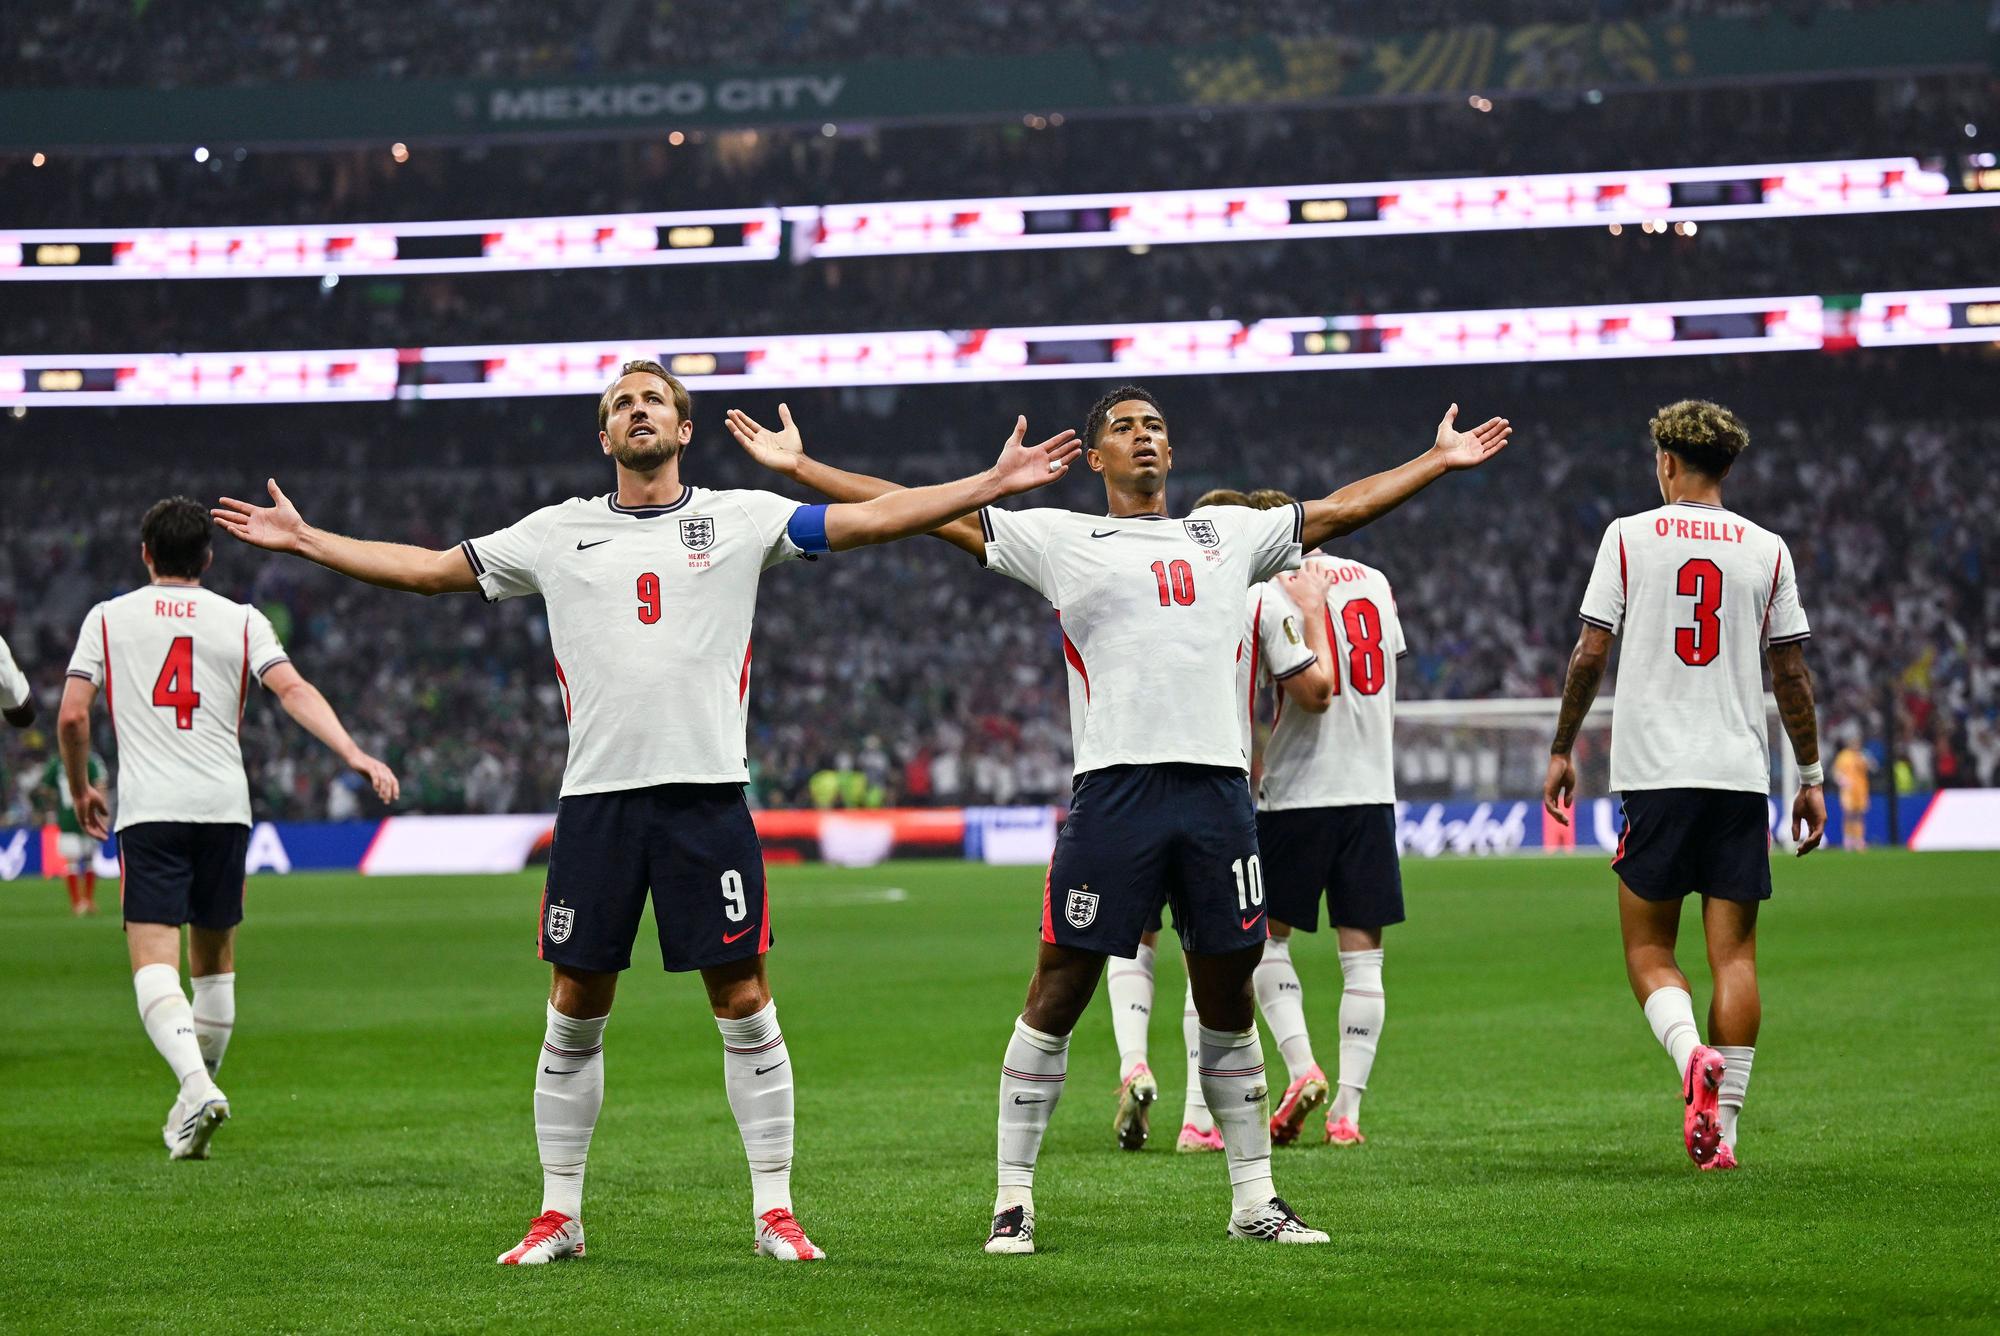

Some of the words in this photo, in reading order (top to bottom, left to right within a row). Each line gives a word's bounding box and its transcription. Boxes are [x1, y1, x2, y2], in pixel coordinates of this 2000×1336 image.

[491, 82, 706, 121] MEXICO
[714, 75, 846, 112] CITY
[1655, 518, 1746, 544] O'REILLY
[637, 572, 662, 625] 9
[1151, 559, 1196, 607] 10
[155, 600, 198, 618] RICE
[1675, 558, 1723, 667] 3
[152, 636, 201, 730] 4
[720, 869, 748, 922] 9
[1231, 854, 1264, 910] 10
[1346, 1026, 1370, 1036] ENG
